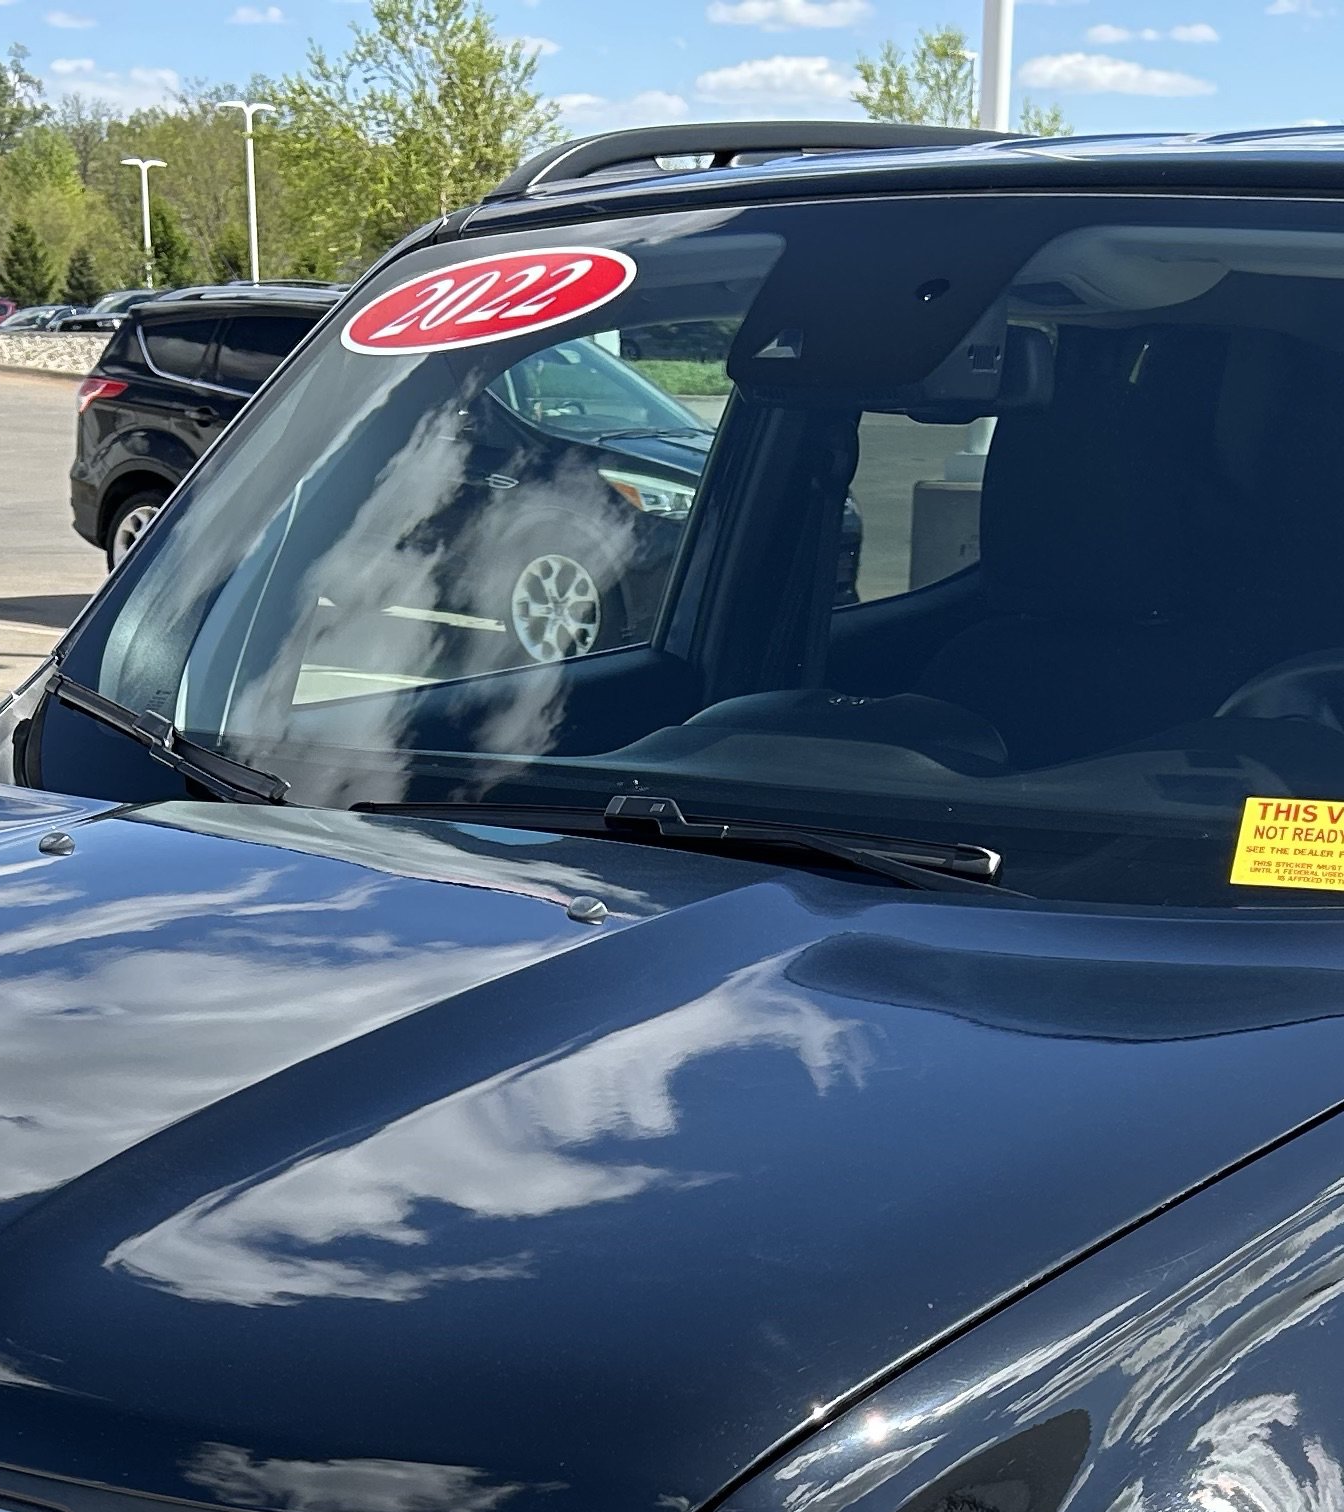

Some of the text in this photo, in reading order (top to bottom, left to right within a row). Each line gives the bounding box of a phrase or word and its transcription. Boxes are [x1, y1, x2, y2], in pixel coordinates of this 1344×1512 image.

[368, 259, 593, 340] 2022
[1258, 803, 1318, 822] THIS
[1253, 825, 1289, 840] NOT
[1270, 846, 1290, 855] THE
[1293, 848, 1334, 857] DEALER
[1275, 861, 1313, 869] STICKER
